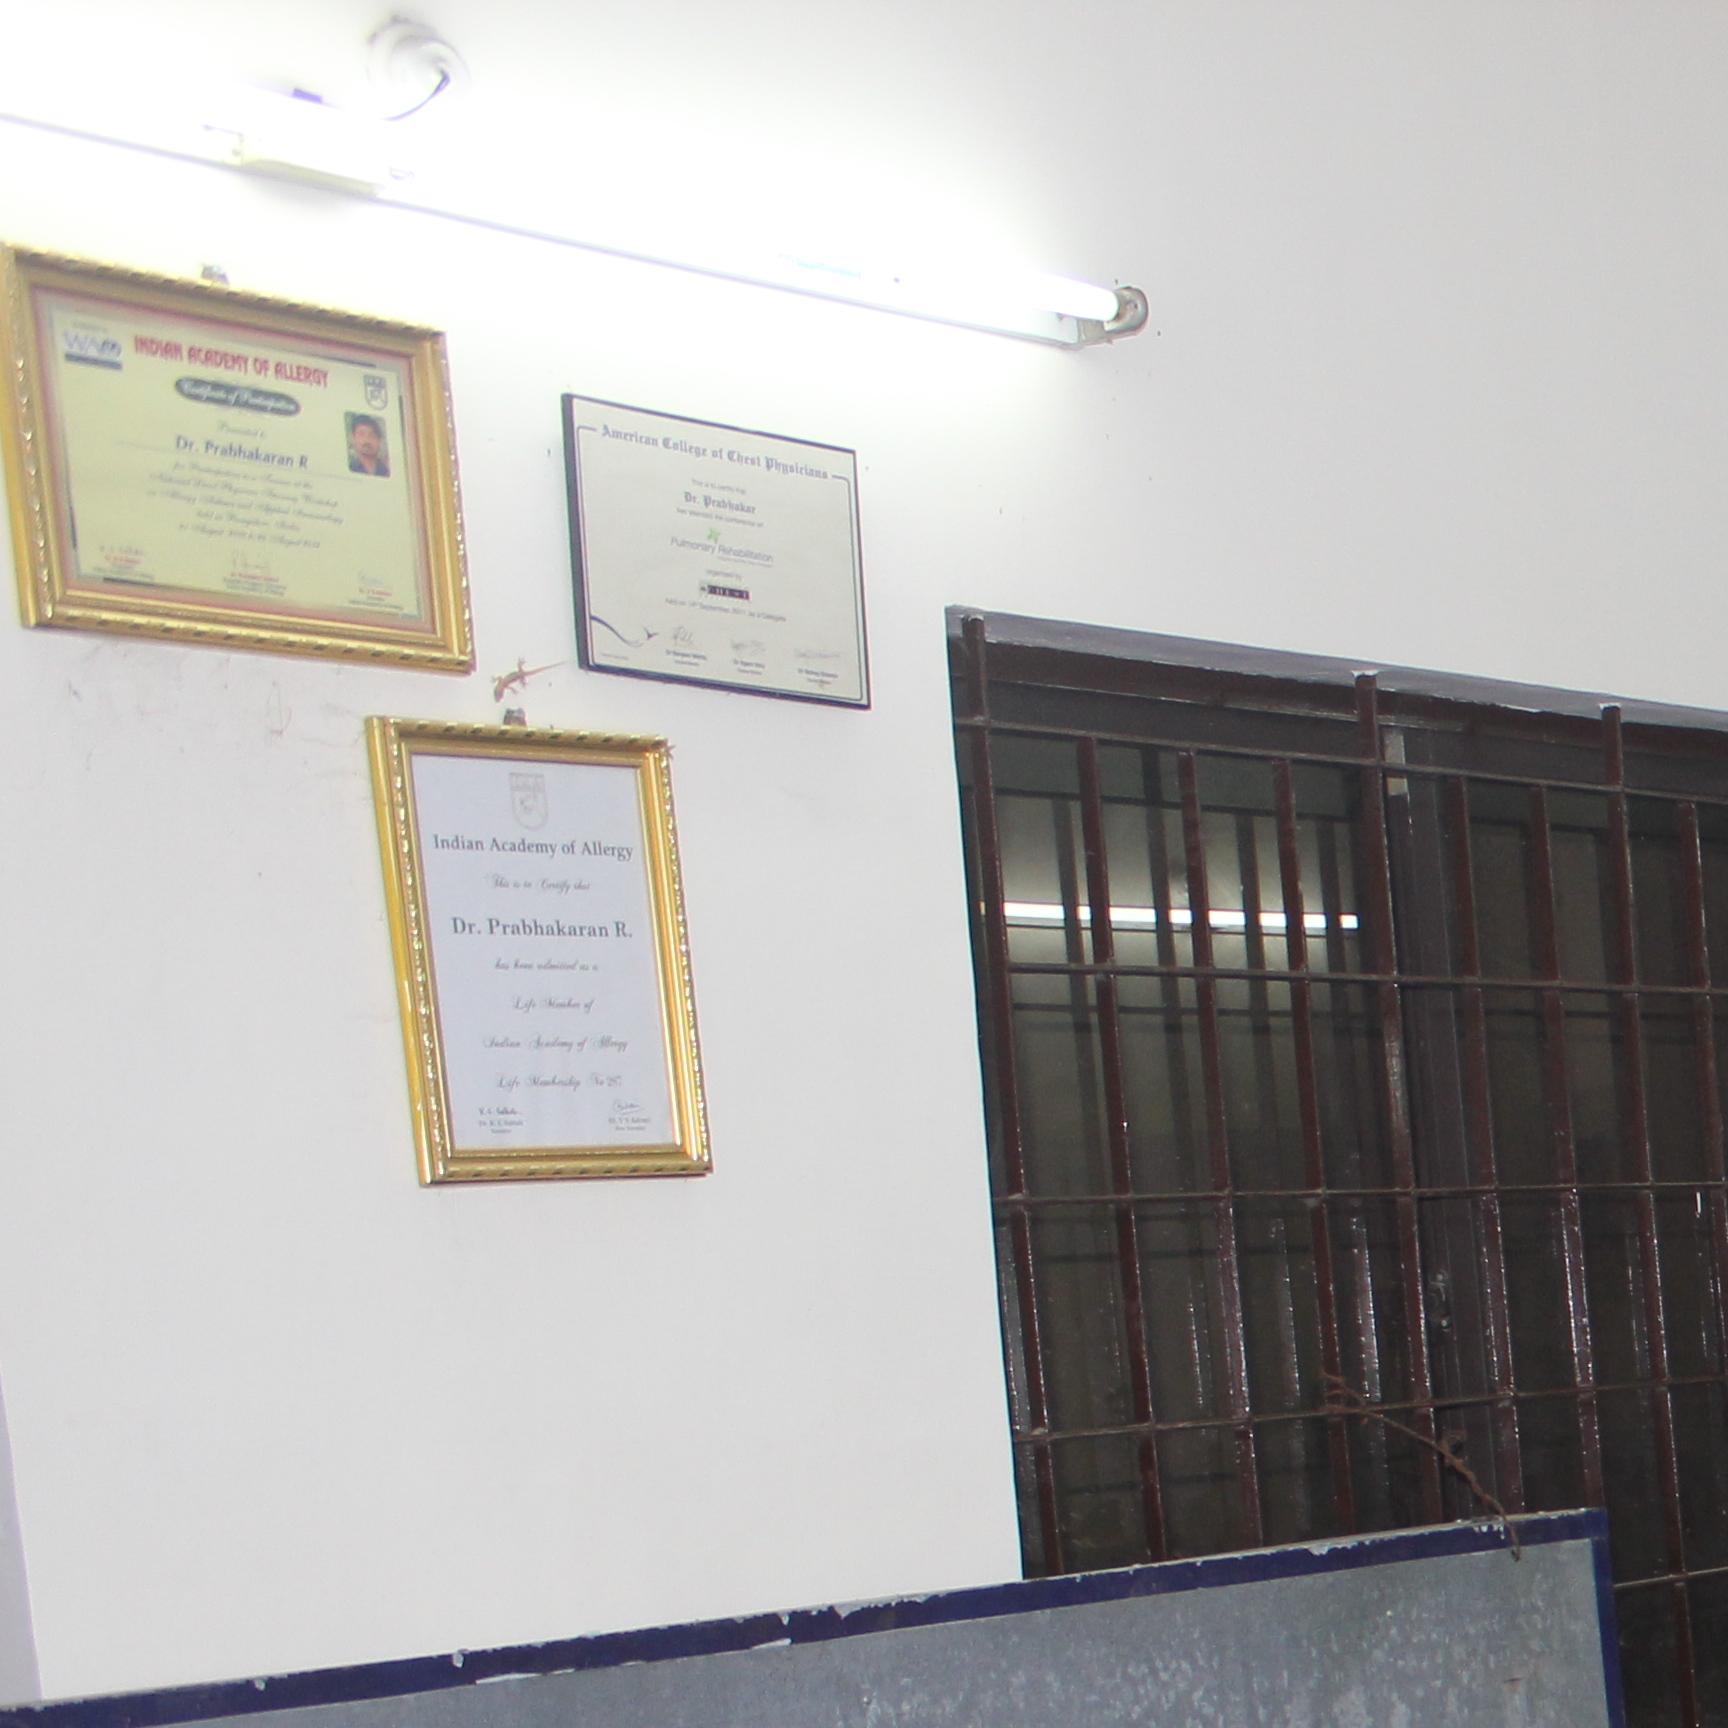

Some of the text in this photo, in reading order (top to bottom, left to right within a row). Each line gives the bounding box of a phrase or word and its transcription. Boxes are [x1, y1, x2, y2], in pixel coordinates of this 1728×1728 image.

[134, 334, 329, 388] INDIAN ACADEMY OF ALLERGY
[174, 434, 309, 468] Dr. Prabhakaran R
[601, 424, 829, 480] American College of Chest Physicians
[432, 834, 634, 862] Indian Academy of Allergy
[452, 916, 634, 939] Dr. Prabhakaran R.
